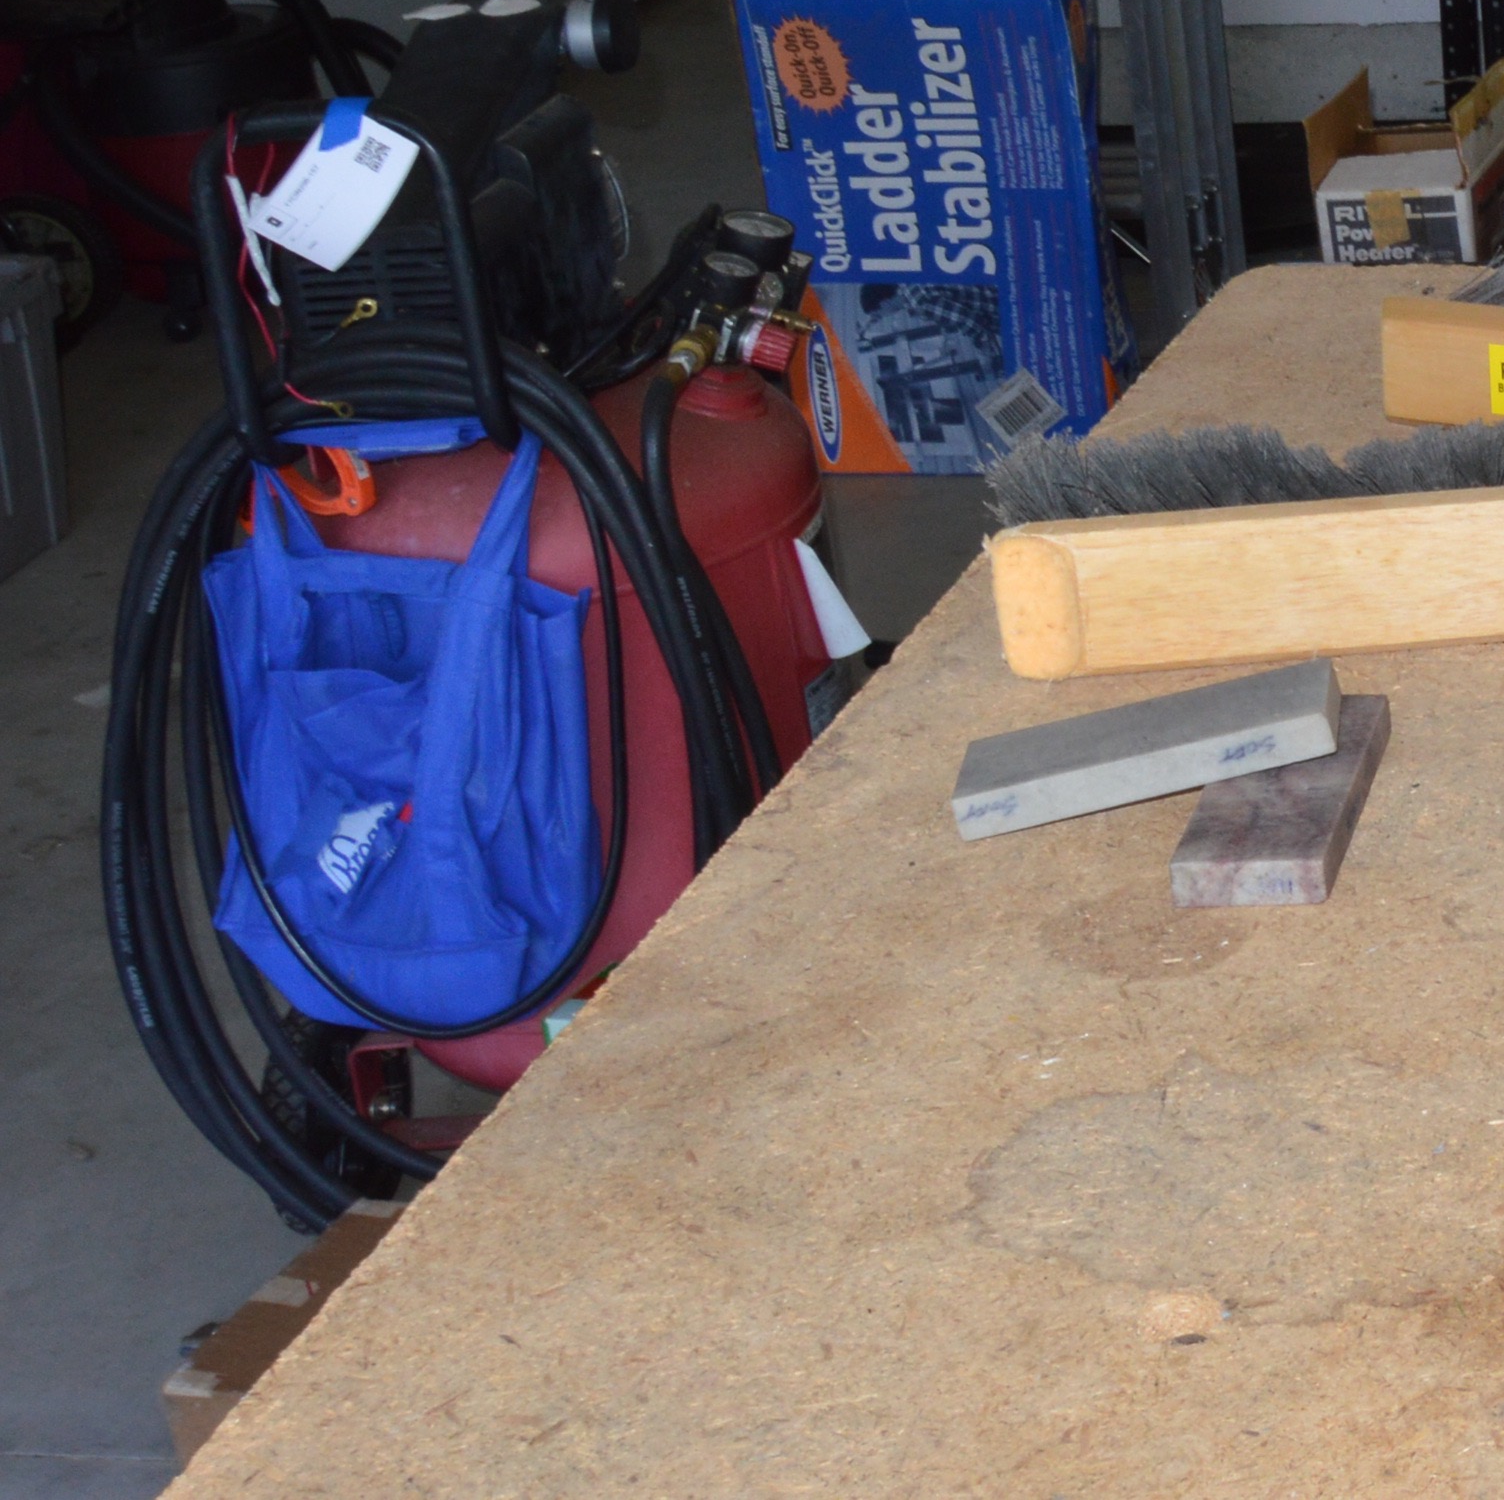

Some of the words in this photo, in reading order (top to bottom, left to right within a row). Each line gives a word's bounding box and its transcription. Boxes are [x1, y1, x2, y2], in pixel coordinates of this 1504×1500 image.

[753, 25, 776, 69] standoff
[783, 29, 817, 99] Quick-On,
[797, 26, 836, 97] Quick-Off
[763, 69, 784, 106] surface
[772, 108, 787, 131] easy
[775, 131, 790, 149] For
[909, 17, 997, 276] Stabilizer
[843, 83, 923, 272] Ladder
[1333, 204, 1422, 222] RIL
[1339, 245, 1415, 262] Heater
[811, 350, 838, 433] WERNER
